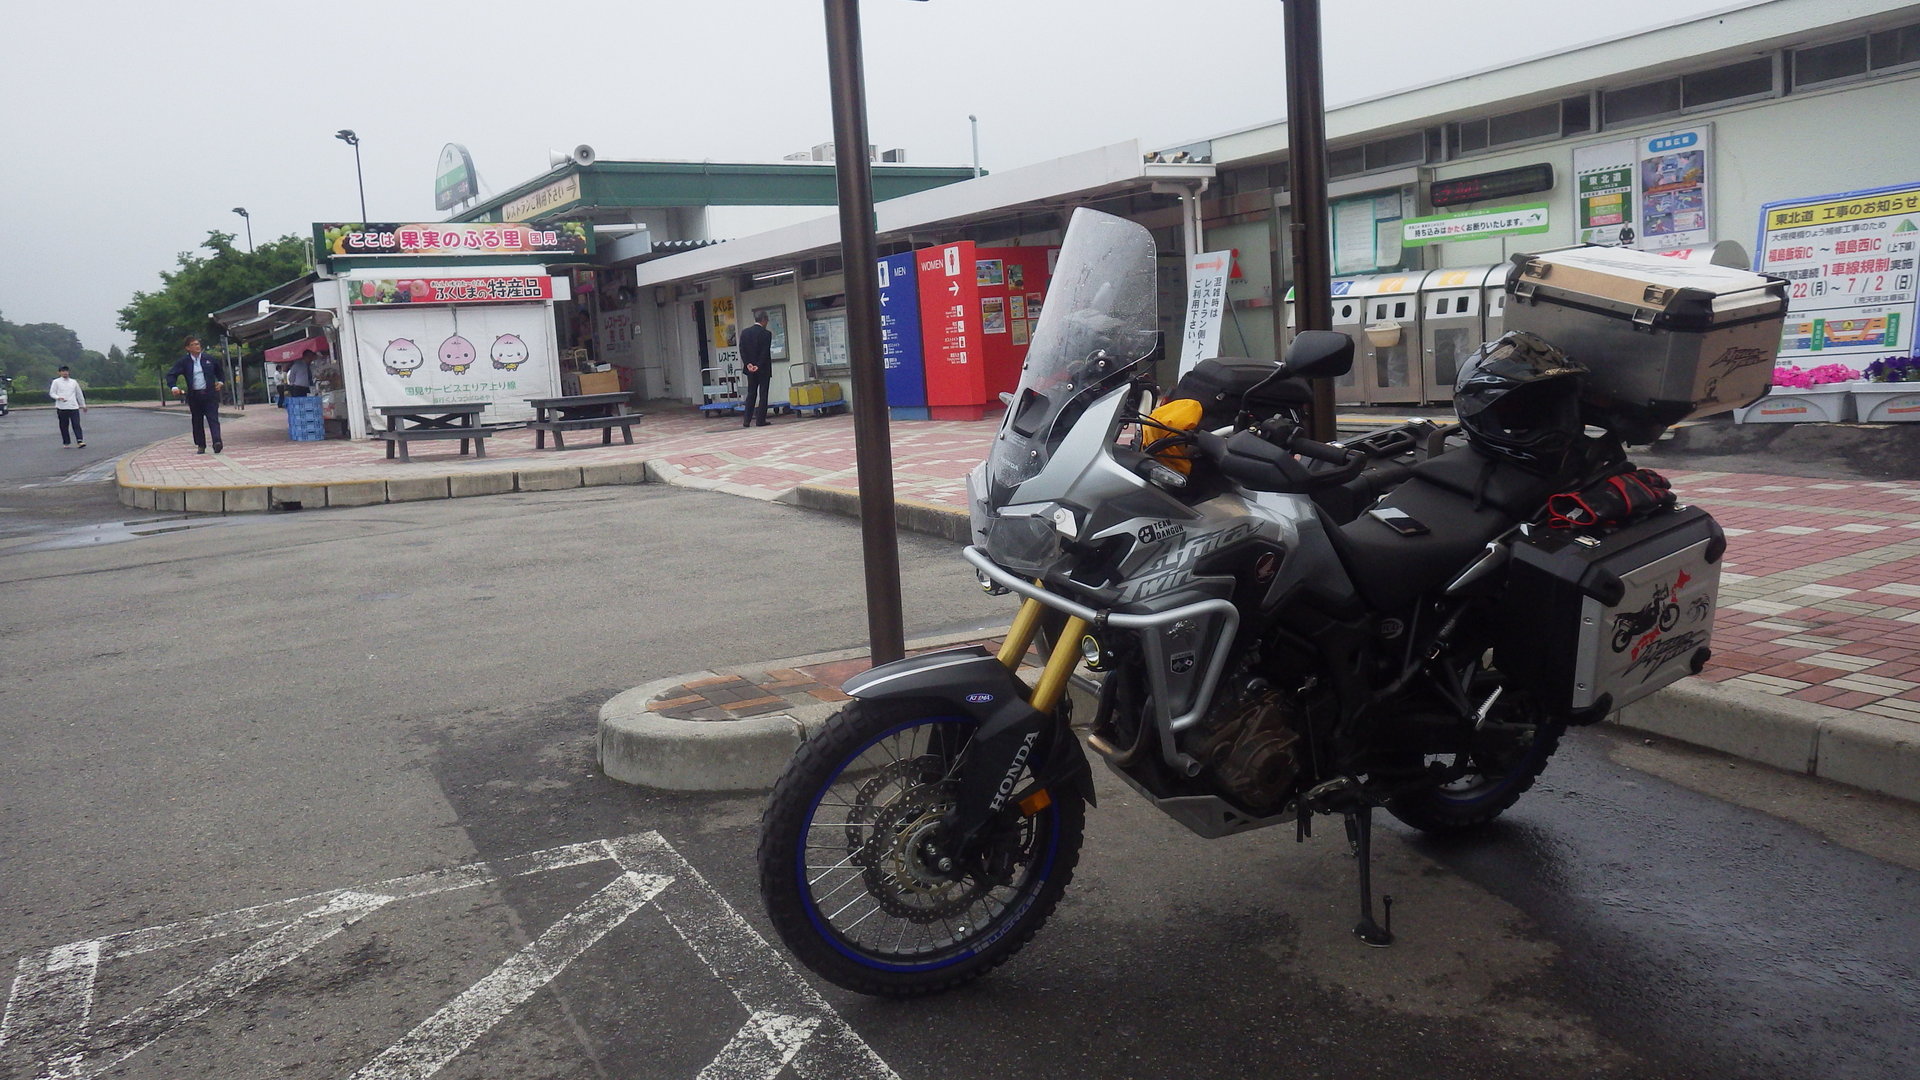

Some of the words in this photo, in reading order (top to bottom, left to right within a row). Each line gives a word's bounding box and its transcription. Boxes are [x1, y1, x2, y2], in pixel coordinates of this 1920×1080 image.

[1775, 210, 1814, 226] 東北道
[1822, 195, 1919, 220] 工事のお知らせ
[1414, 218, 1524, 238] 持ち込みはかたくお断りいたします。
[349, 231, 395, 247] ここは
[400, 230, 522, 249] 果実のふる里
[528, 231, 557, 246] 国見
[1834, 238, 1882, 255] 福島西IC
[893, 266, 907, 277] MEN
[921, 259, 944, 272] WOMEN
[436, 278, 542, 300] ふくしまの特産品
[404, 381, 517, 396] 国見サービスエリア上り線
[1153, 519, 1172, 530] TEAM
[1156, 524, 1184, 540] DANGUN
[1120, 566, 1195, 601] Twin
[989, 731, 1041, 812] HONDA
